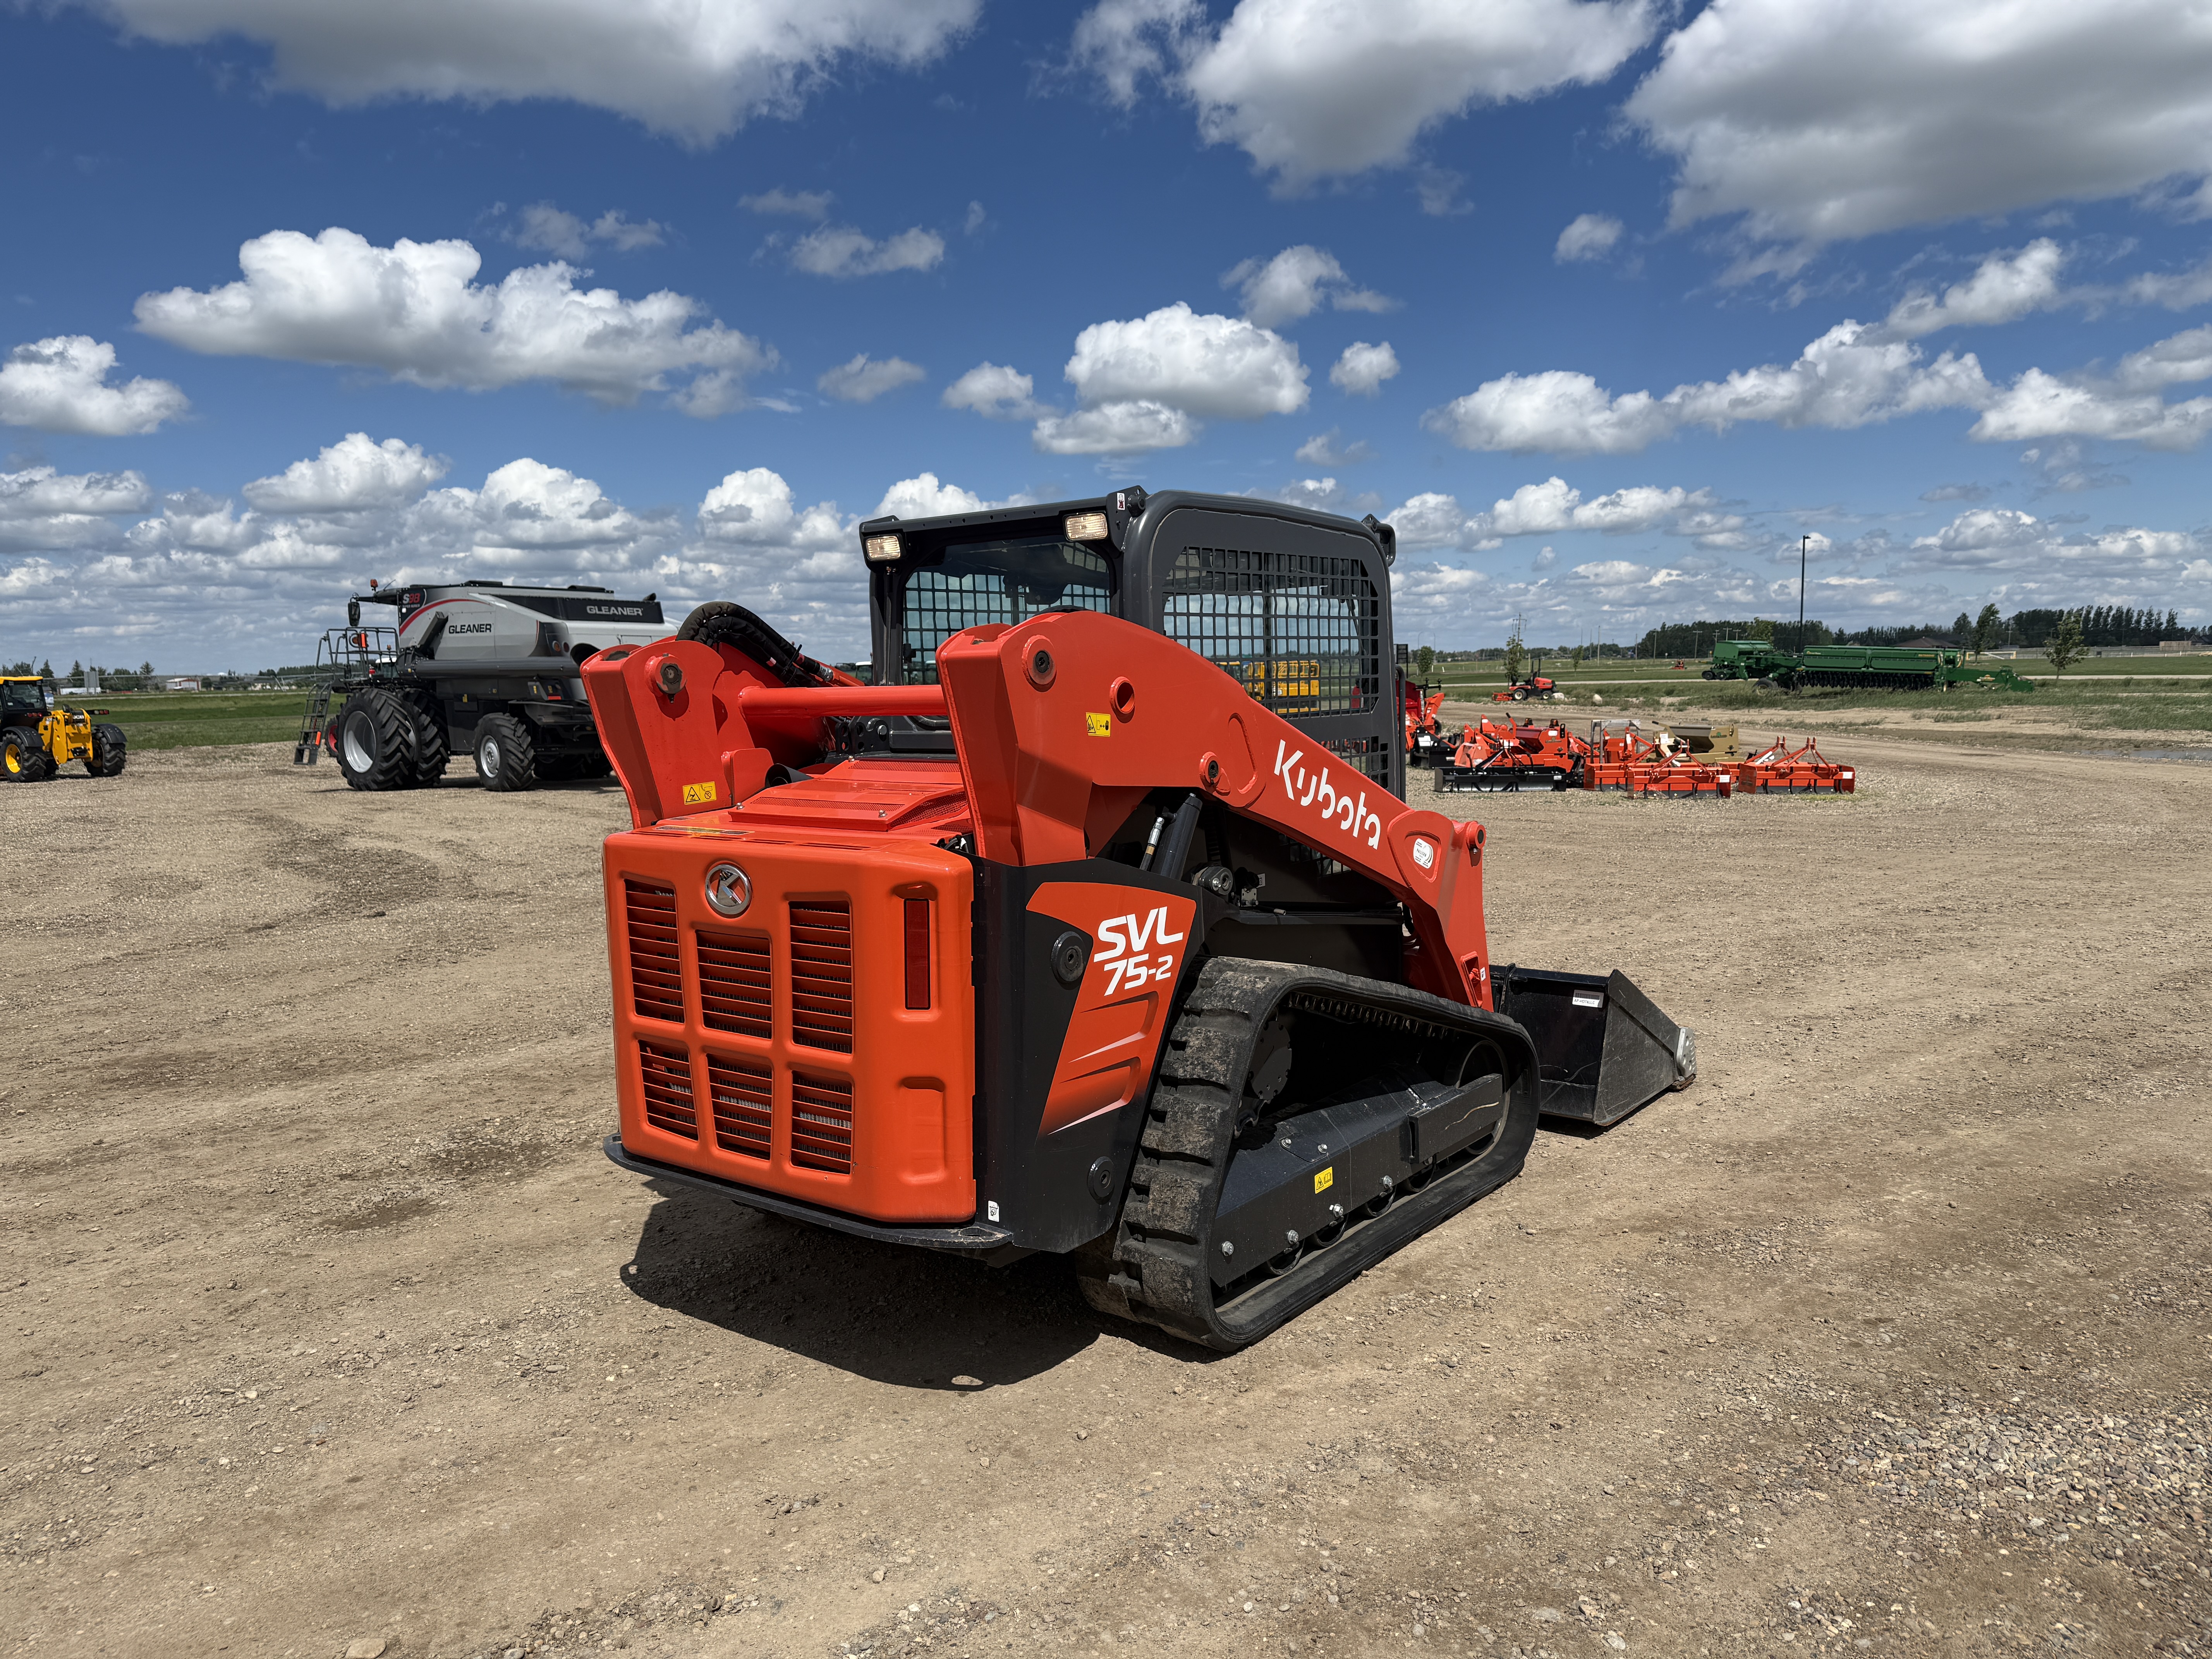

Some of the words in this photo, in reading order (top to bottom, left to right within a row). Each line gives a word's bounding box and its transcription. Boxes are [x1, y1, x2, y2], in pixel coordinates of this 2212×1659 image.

[403, 593, 421, 604] S98
[587, 605, 643, 616] GLEANER
[449, 623, 492, 634] GLEANER
[1274, 739, 1381, 850] Kubota
[1094, 906, 1183, 963] SVL
[1104, 953, 1173, 997] 75-2
